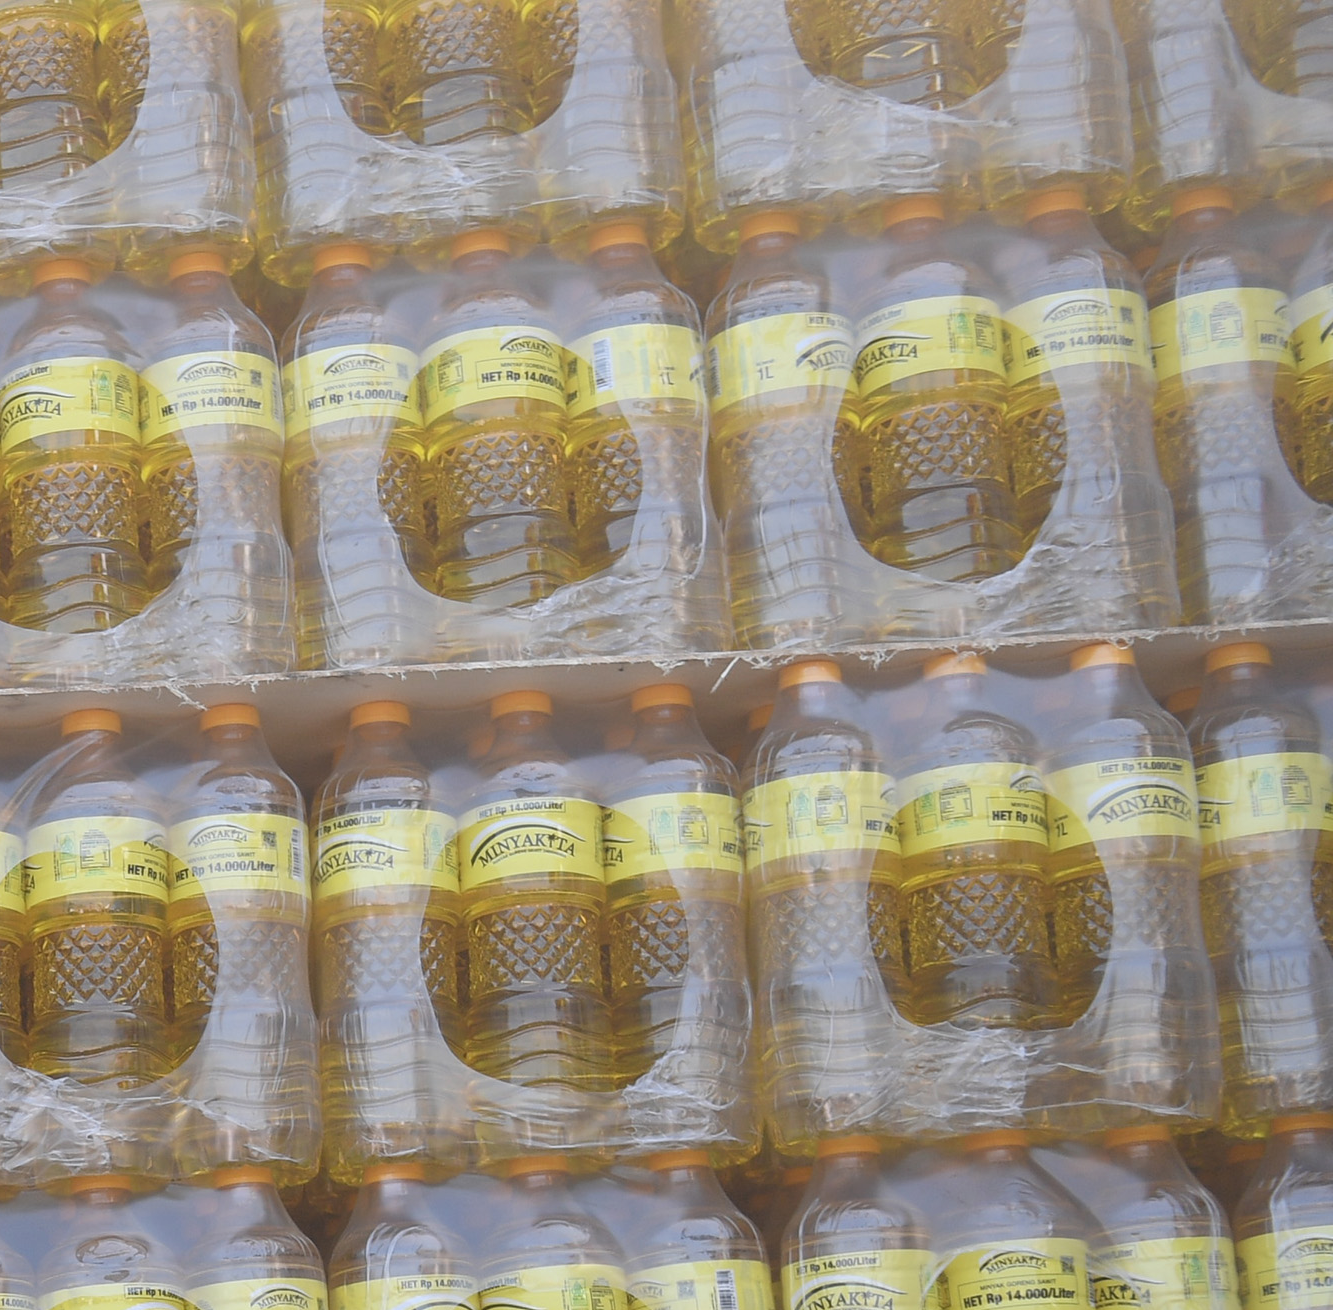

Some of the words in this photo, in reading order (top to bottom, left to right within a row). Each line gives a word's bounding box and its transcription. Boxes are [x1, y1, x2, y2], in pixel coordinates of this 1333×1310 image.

[161, 404, 178, 418] HET
[183, 400, 196, 413] Rp
[200, 396, 262, 410] 14.000/Liter
[308, 396, 325, 410] HET
[328, 393, 343, 406] Rp
[348, 388, 408, 404] 14.000/Liter
[1101, 763, 1118, 774] HET
[509, 801, 564, 813] 14.000/Liter
[992, 810, 1013, 823] HET
[1016, 811, 1028, 825] Rp
[1056, 822, 1068, 837] 1L
[479, 834, 575, 868] MINYAKITA
[175, 869, 189, 884] HET
[192, 864, 205, 879] Rp
[208, 860, 275, 875] 14.000/Liter
[823, 1255, 878, 1271] 14.000/Liter
[963, 1295, 982, 1309] HET
[986, 1292, 1002, 1306] Rp
[1007, 1288, 1075, 1303] 14.000/Liter
